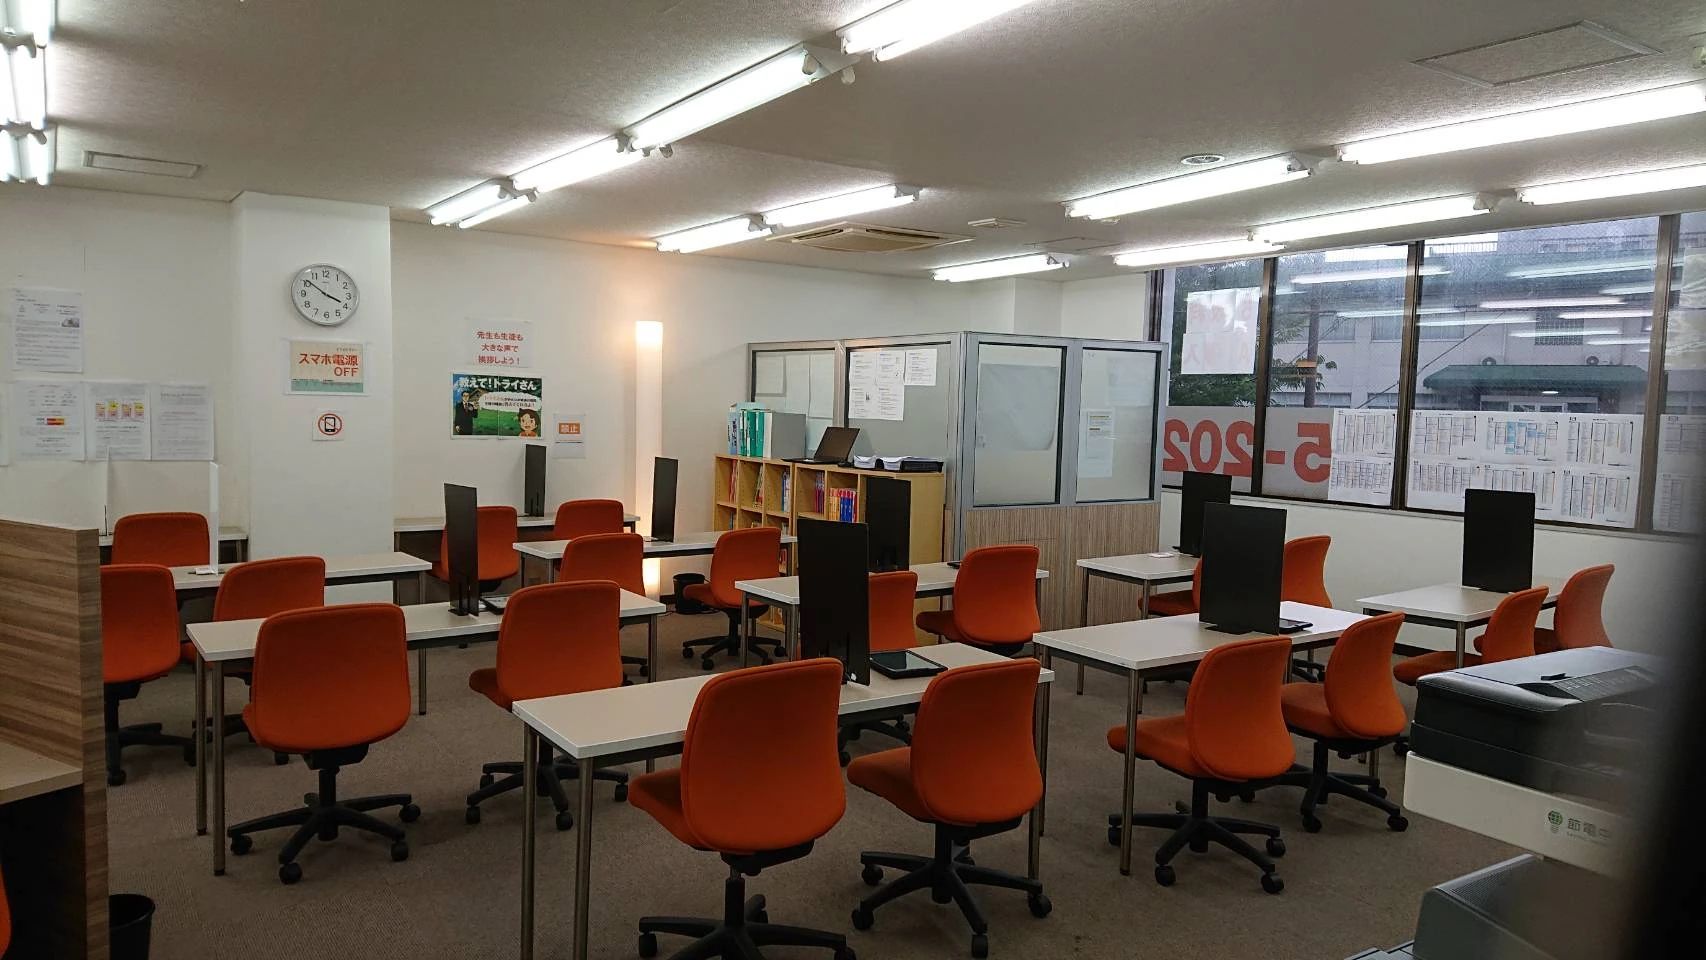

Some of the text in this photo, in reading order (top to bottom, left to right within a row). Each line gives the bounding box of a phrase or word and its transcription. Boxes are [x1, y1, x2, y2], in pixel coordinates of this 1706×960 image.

[322, 270, 329, 278] 12
[342, 282, 348, 290] 2
[346, 292, 352, 300] 3
[313, 308, 319, 316] 7
[335, 309, 341, 317] 5
[481, 343, 519, 353] 大きな声で
[299, 353, 358, 366] スマホ電源
[334, 367, 359, 377] OFF
[560, 424, 579, 433] 禁止
